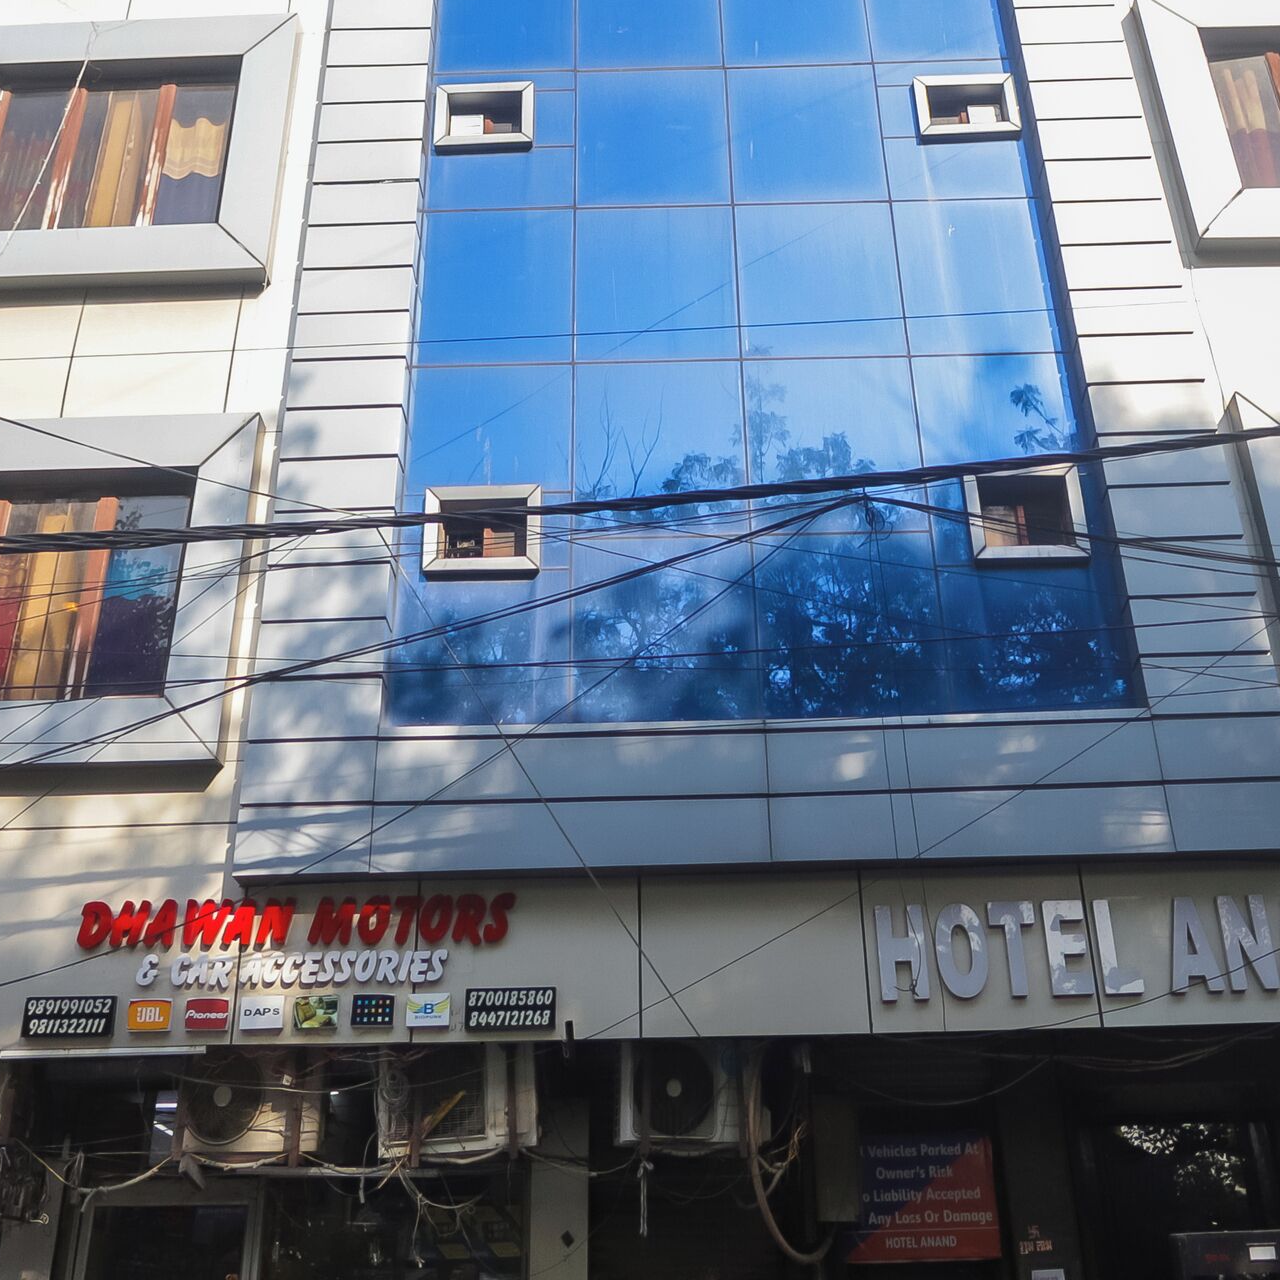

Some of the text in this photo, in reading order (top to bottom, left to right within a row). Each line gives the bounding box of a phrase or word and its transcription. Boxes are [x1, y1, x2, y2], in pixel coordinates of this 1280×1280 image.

[76, 892, 517, 951] DHAWAN MOTORS
[874, 899, 1146, 1003] HOTEL
[135, 948, 450, 988] & CAR ACCESSORIES
[468, 990, 553, 1006] 8700185860
[27, 999, 111, 1015] 9891991052
[136, 1007, 163, 1023] JBL
[185, 1009, 229, 1021] Pioneer
[28, 1018, 106, 1035] 9811322111
[469, 1010, 550, 1027] 8447121268
[867, 1145, 918, 1158] Vehicles
[921, 1143, 961, 1157] Parked
[964, 1142, 980, 1156] At
[876, 1165, 954, 1179] Owner's Risk
[873, 1189, 922, 1203] Liability
[926, 1186, 981, 1202] Accepted
[868, 1210, 993, 1228] Any Loss Or Damage
[886, 1236, 957, 1249] HOTEL ANAND
